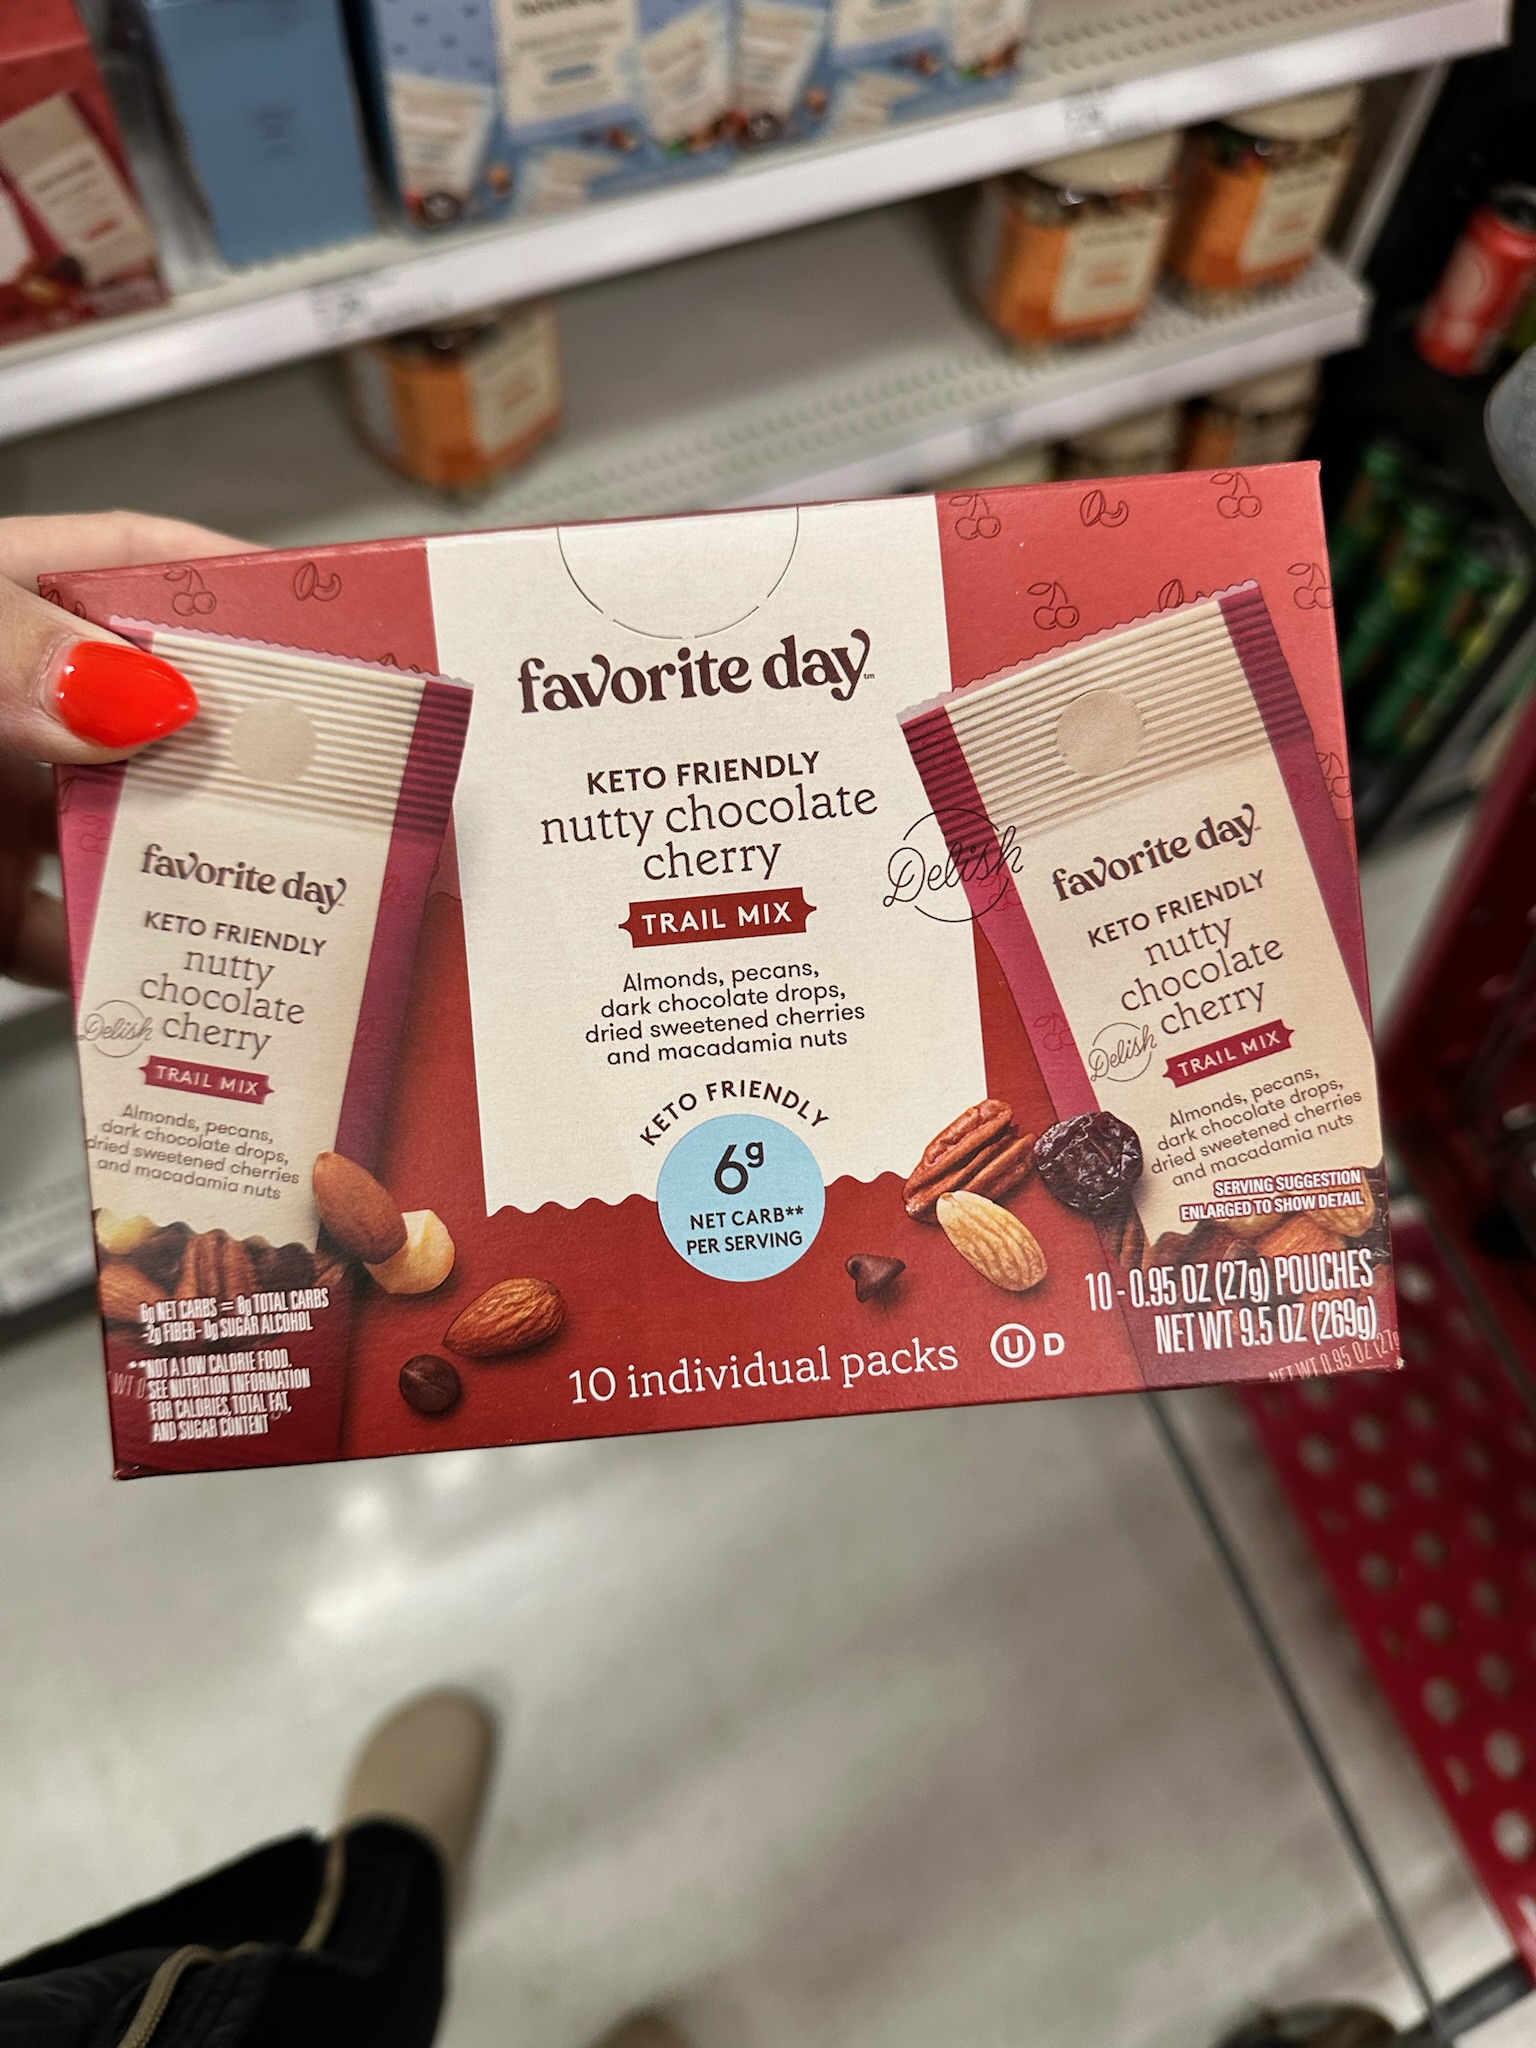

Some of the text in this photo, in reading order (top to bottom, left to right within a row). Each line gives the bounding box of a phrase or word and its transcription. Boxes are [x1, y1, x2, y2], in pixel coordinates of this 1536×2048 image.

[518, 646, 752, 714] favorite
[762, 628, 871, 701] day
[587, 751, 819, 795] KETO FRIENDLY
[541, 783, 878, 846] nutty chocolate
[643, 841, 781, 880] cherry
[883, 825, 1024, 907] Delish
[1052, 803, 1255, 901] favorite day
[141, 843, 347, 914] favorite day
[642, 901, 793, 936] TRAIL MIX
[1087, 869, 1264, 948] KETO FRIENDLY
[144, 910, 327, 957] KETO FRIENDLY
[1144, 918, 1232, 966] nutty
[184, 950, 275, 990] nutty
[622, 960, 820, 993] Almonds, pecans,
[1121, 939, 1284, 1011] chocolate
[141, 973, 304, 1024] chocolate
[601, 983, 846, 1019] dark chocolate drops,
[1161, 981, 1264, 1035] cherry
[79, 1013, 153, 1042] Delish
[162, 1012, 272, 1060] cherry
[585, 1003, 865, 1044] dried sweetened cherries
[607, 1028, 848, 1066] and macadamia nuts
[1088, 1024, 1157, 1082] Delish
[1177, 1030, 1281, 1077] TRAIL MIX
[156, 1065, 259, 1096] TRAIL MIX
[1169, 1067, 1319, 1128] Almonds, pecans,
[122, 1103, 274, 1144] Almonds, pecans,
[640, 1080, 829, 1146] KETO FRIENDLY
[1151, 1090, 1362, 1175] dried sweetened cherries
[1157, 1079, 1344, 1151] dark chocolate drops,
[87, 1135, 300, 1184] dried sweetened cherries
[102, 1119, 289, 1165] dark chocolate drops,
[1172, 1111, 1354, 1187] and macadamia nuts
[97, 1157, 281, 1200] and macadamia nuts
[714, 1141, 764, 1195] 6g
[1213, 1169, 1361, 1197] SERVING SUGGESTION
[690, 1212, 726, 1230] NET
[1180, 1190, 1364, 1221] ENLARGED TO SHOW DETAIL
[687, 1230, 802, 1255] PER SERVING
[1084, 1271, 1112, 1311] 10
[1129, 1266, 1177, 1308] 0.95
[1181, 1262, 1209, 1304] OZ
[1215, 1257, 1270, 1305] (27g)
[1274, 1248, 1374, 1296] POUCHES
[157, 1300, 178, 1322] NET
[180, 1297, 217, 1320] CARBS
[252, 1291, 288, 1314] TOTAL
[291, 1287, 329, 1310] CARBS
[220, 1314, 259, 1338] SUGAR
[262, 1311, 313, 1334] ALCOHOL
[1154, 1296, 1378, 1355] NET WT 9.5 OZ (269g)
[170, 1357, 180, 1377] A
[182, 1355, 207, 1376] LOW
[208, 1351, 255, 1375] CALORIE
[258, 1348, 292, 1370] FOOD.
[1043, 1332, 1065, 1356] D
[148, 1368, 310, 1400] SEE NUTRITION INFORMATION
[568, 1337, 959, 1404] 10 individual packs
[150, 1400, 173, 1421] FOR
[174, 1396, 231, 1420] CALORIES,
[232, 1394, 267, 1415] TOTAL
[152, 1414, 269, 1442] AND SUGAR CONTENT
